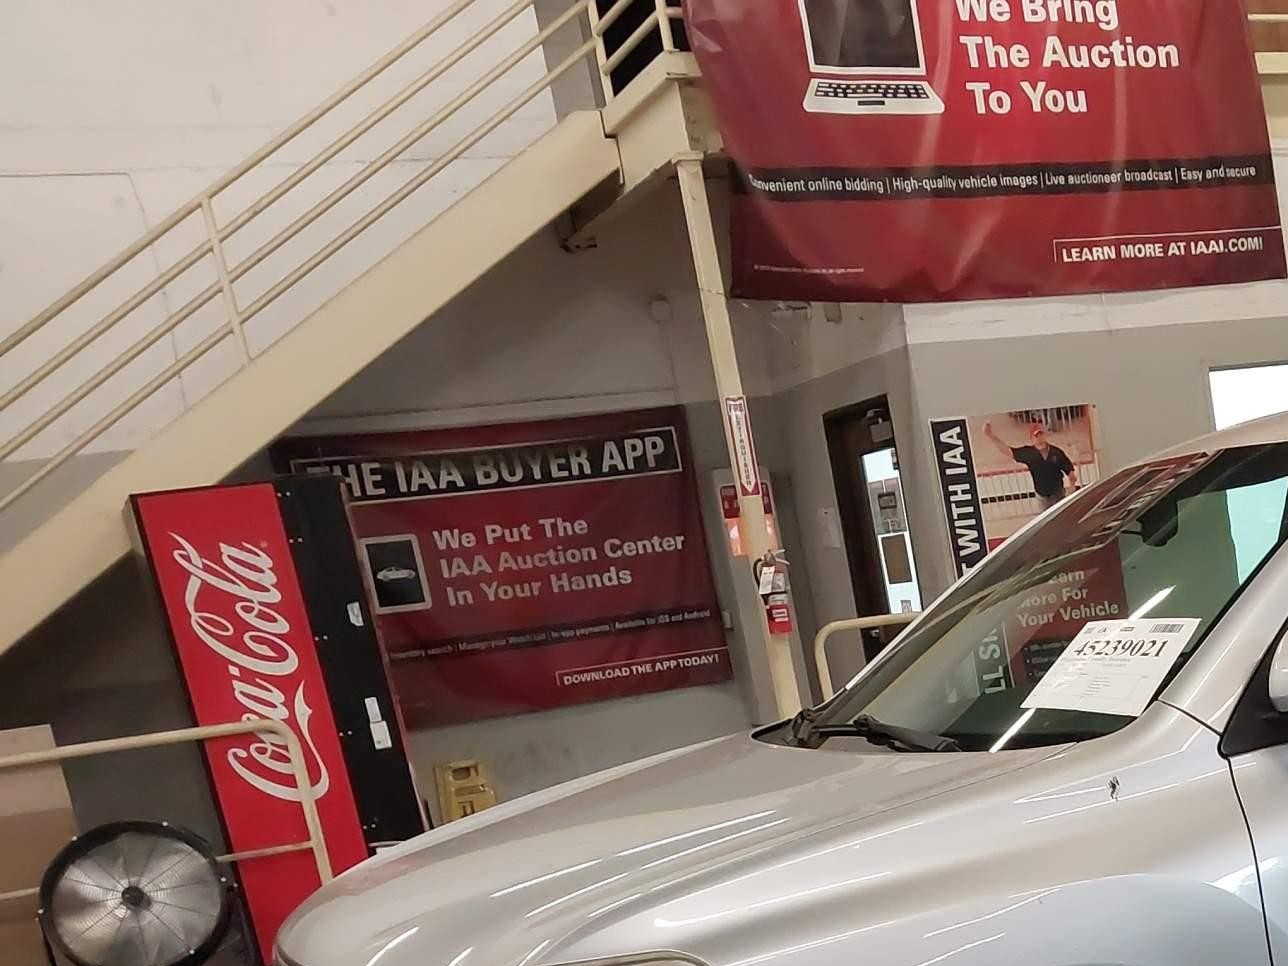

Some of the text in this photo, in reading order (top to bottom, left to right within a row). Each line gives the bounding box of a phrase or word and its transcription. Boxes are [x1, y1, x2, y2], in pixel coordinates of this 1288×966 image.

[955, 0, 1119, 30] We Bring
[959, 35, 1180, 68] The Auction
[965, 81, 1088, 114] To You
[808, 177, 843, 191] online
[845, 177, 884, 194] bidding
[893, 174, 957, 193] High-quality
[958, 175, 997, 189] vehicle
[999, 173, 1038, 188] images
[1046, 172, 1065, 186] Live
[1068, 170, 1121, 184] auctioneer
[1125, 168, 1173, 182] broadcast
[1181, 168, 1202, 182] Easy
[1206, 164, 1224, 178] and
[1226, 165, 1256, 177] secure
[1062, 236, 1263, 263] LEARN MORE AT IAAI.COM!
[398, 460, 466, 493] IAA
[476, 445, 591, 486] BUYER
[602, 436, 665, 473] APP
[939, 425, 968, 476] IAA
[432, 517, 588, 550] We Put The
[948, 483, 981, 557] WITH
[440, 535, 685, 578] IAA Auction Center
[447, 567, 632, 607] In Your Hands
[1048, 570, 1085, 584] arn
[1062, 587, 1088, 601] For
[1017, 601, 1119, 627] Your Vehicle
[1073, 640, 1169, 657] 45239021
[563, 653, 719, 686] DOWNLOAD THE APP TODAY!
